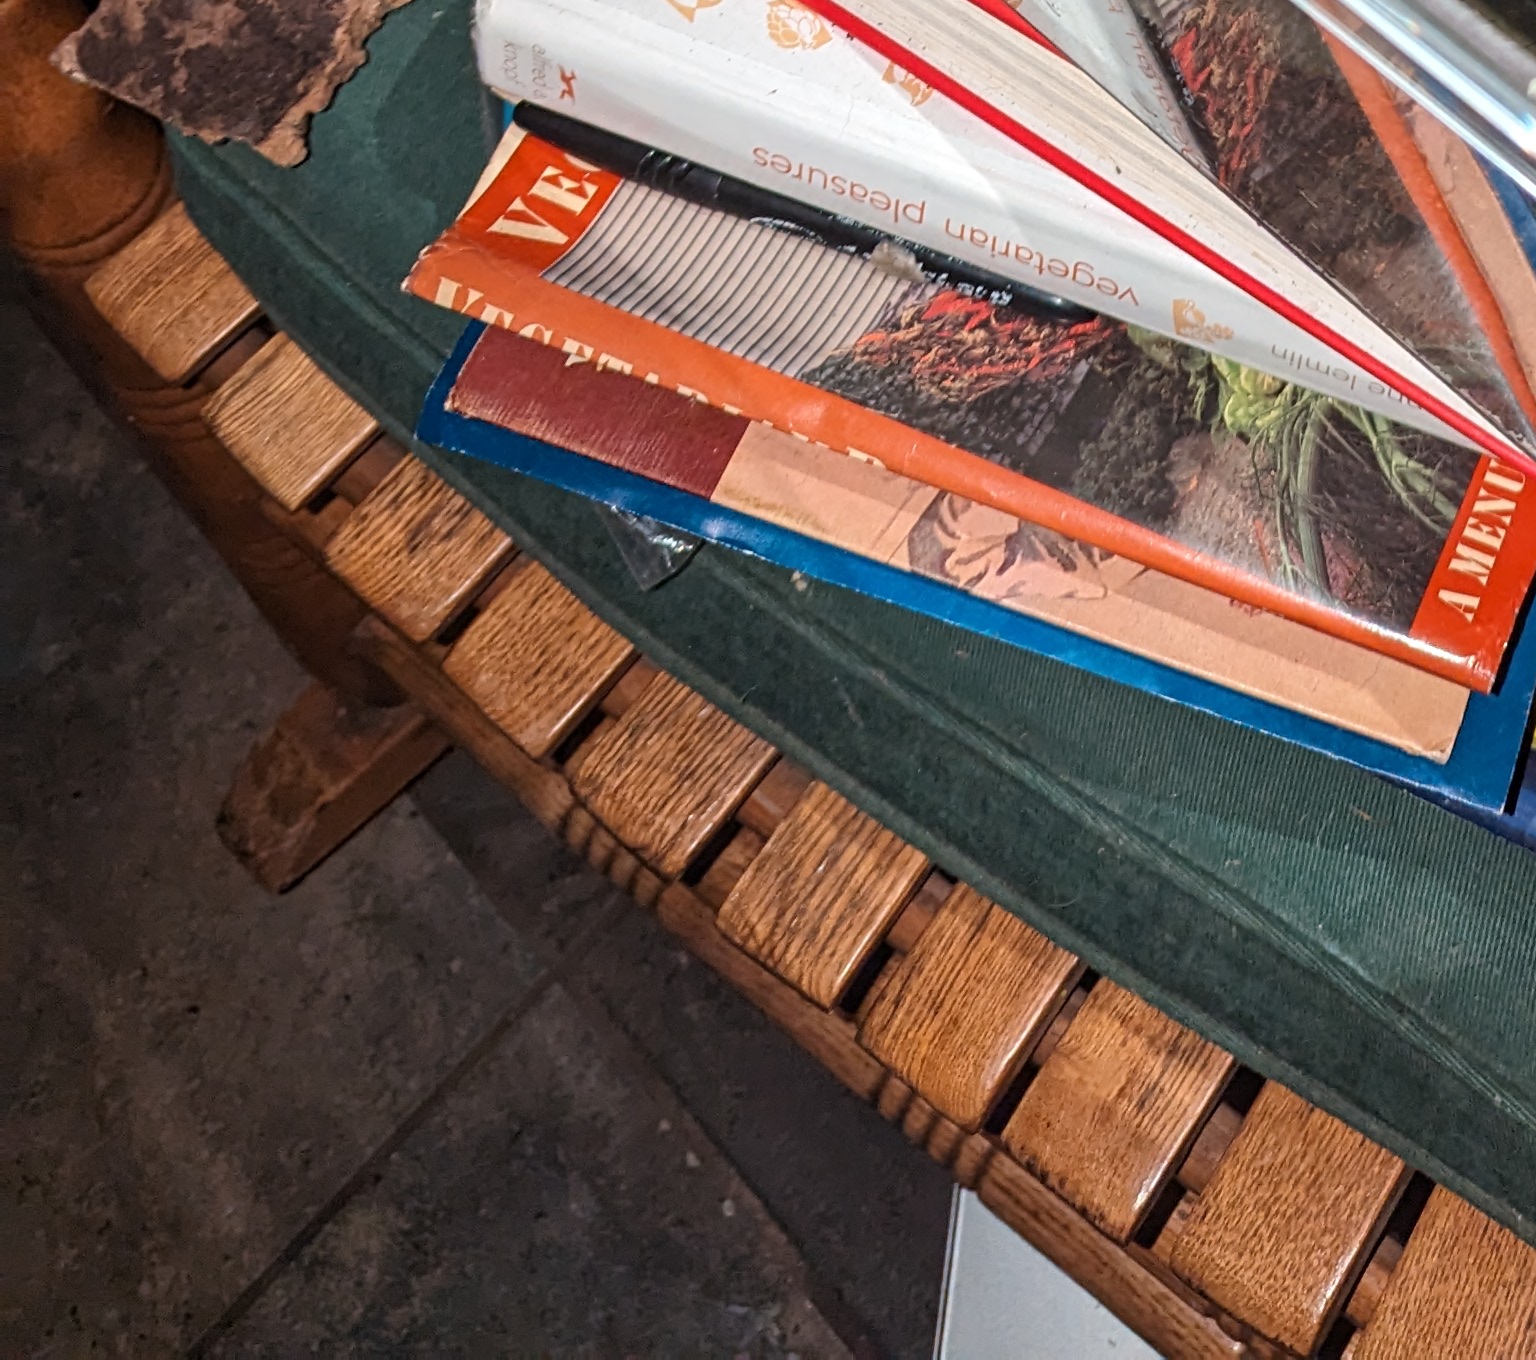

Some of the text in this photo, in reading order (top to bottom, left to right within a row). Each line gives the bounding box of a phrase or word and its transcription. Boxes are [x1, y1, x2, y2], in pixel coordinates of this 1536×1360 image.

[486, 153, 602, 245] VE
[752, 146, 926, 225] pleasures
[945, 218, 1141, 307] vegetarian
[1271, 344, 1357, 391] lemlin
[1438, 458, 1526, 623] A MENU
